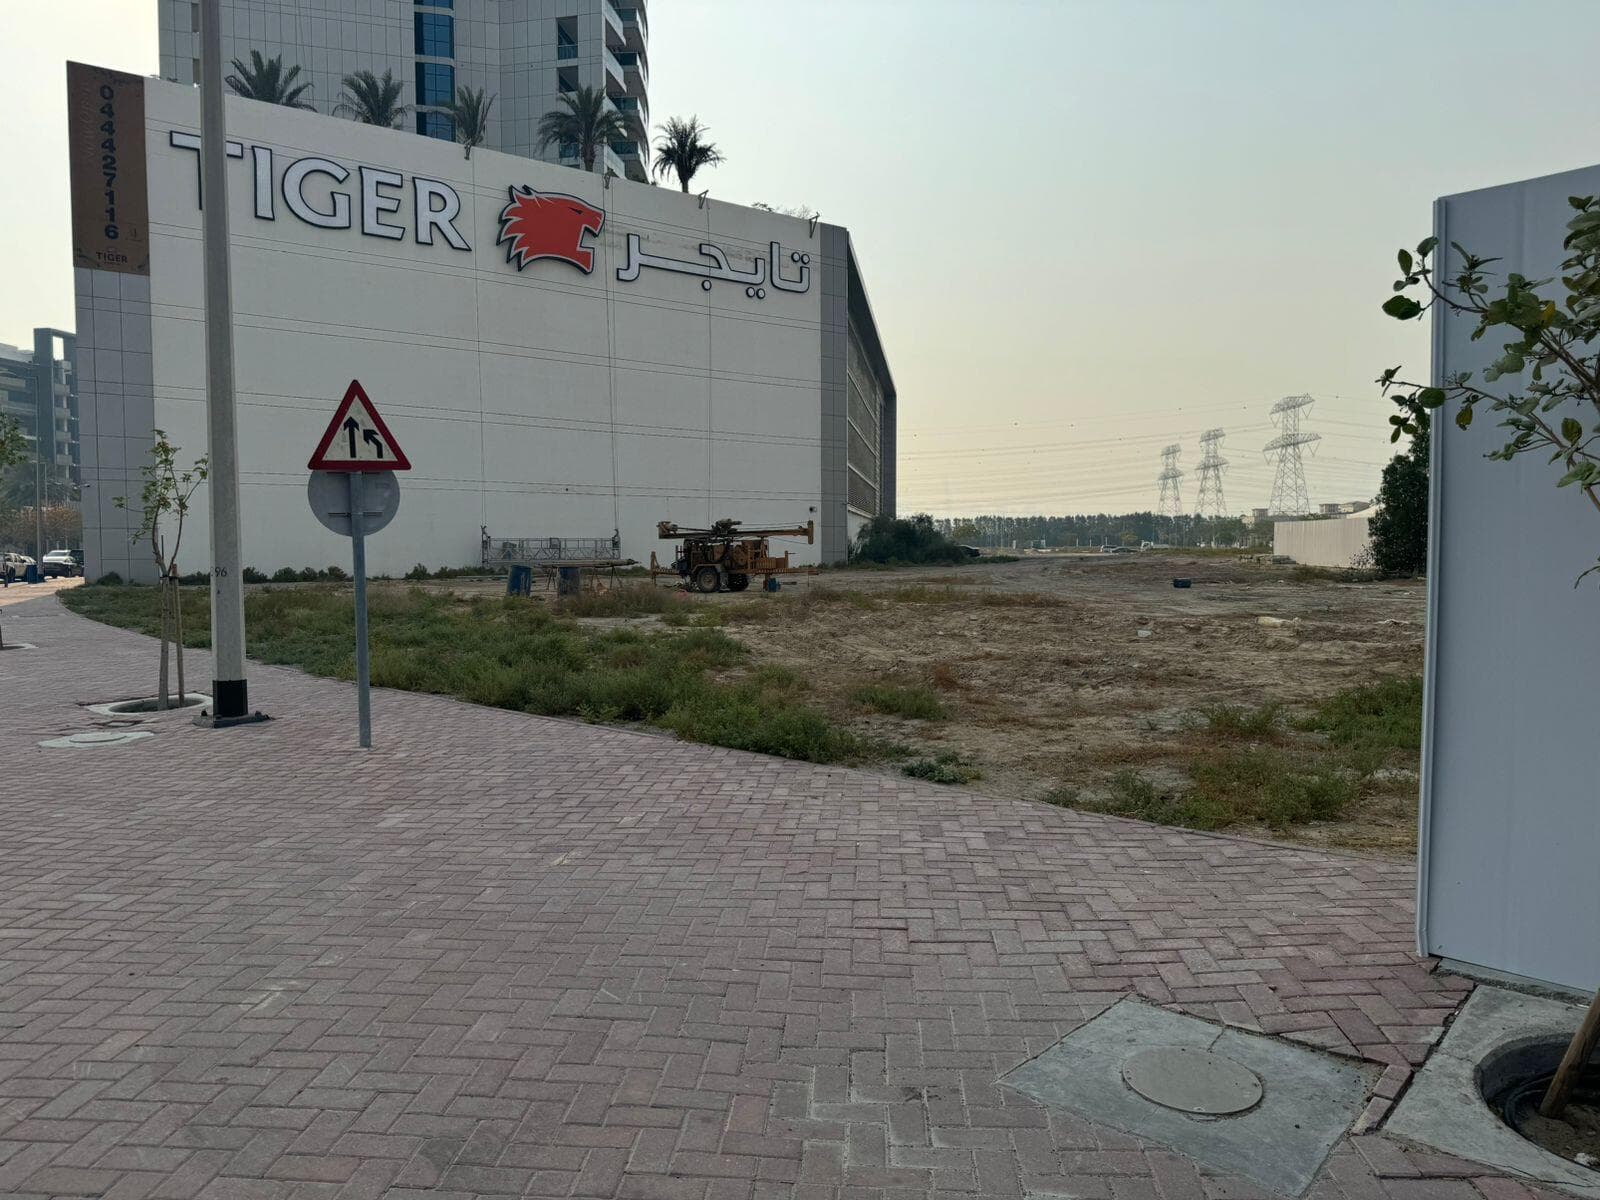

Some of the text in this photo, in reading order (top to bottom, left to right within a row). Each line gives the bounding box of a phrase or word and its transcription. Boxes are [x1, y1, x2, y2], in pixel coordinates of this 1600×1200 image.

[100, 84, 119, 239] 044427116
[95, 251, 128, 263] TIGER
[616, 233, 811, 299] تايجر
